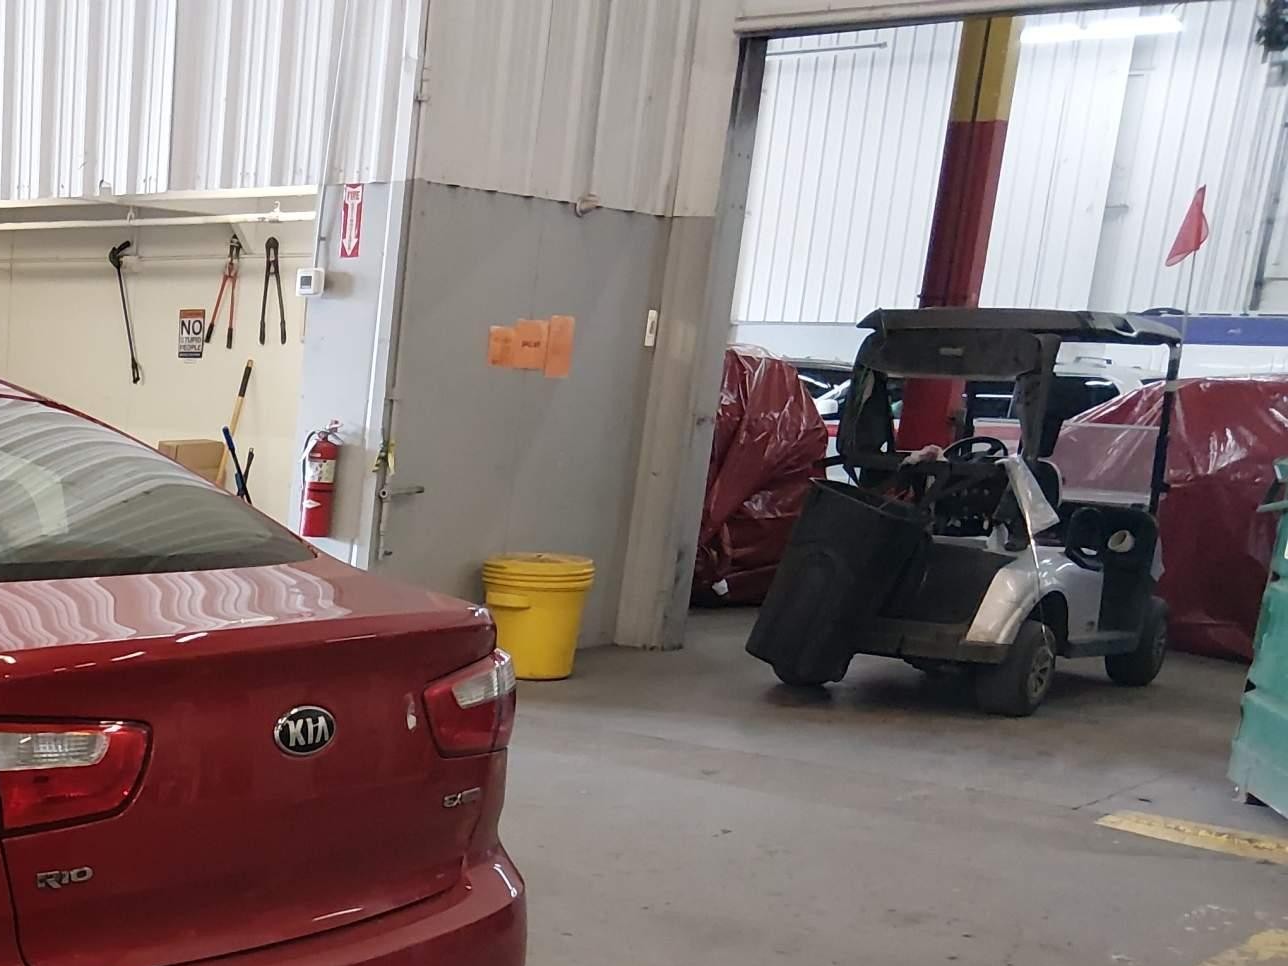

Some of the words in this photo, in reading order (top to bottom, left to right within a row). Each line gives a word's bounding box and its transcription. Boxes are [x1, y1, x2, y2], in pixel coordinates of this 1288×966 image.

[347, 190, 361, 201] FIRE
[181, 319, 203, 336] NO
[285, 715, 330, 747] KIA
[36, 866, 93, 889] RIO
